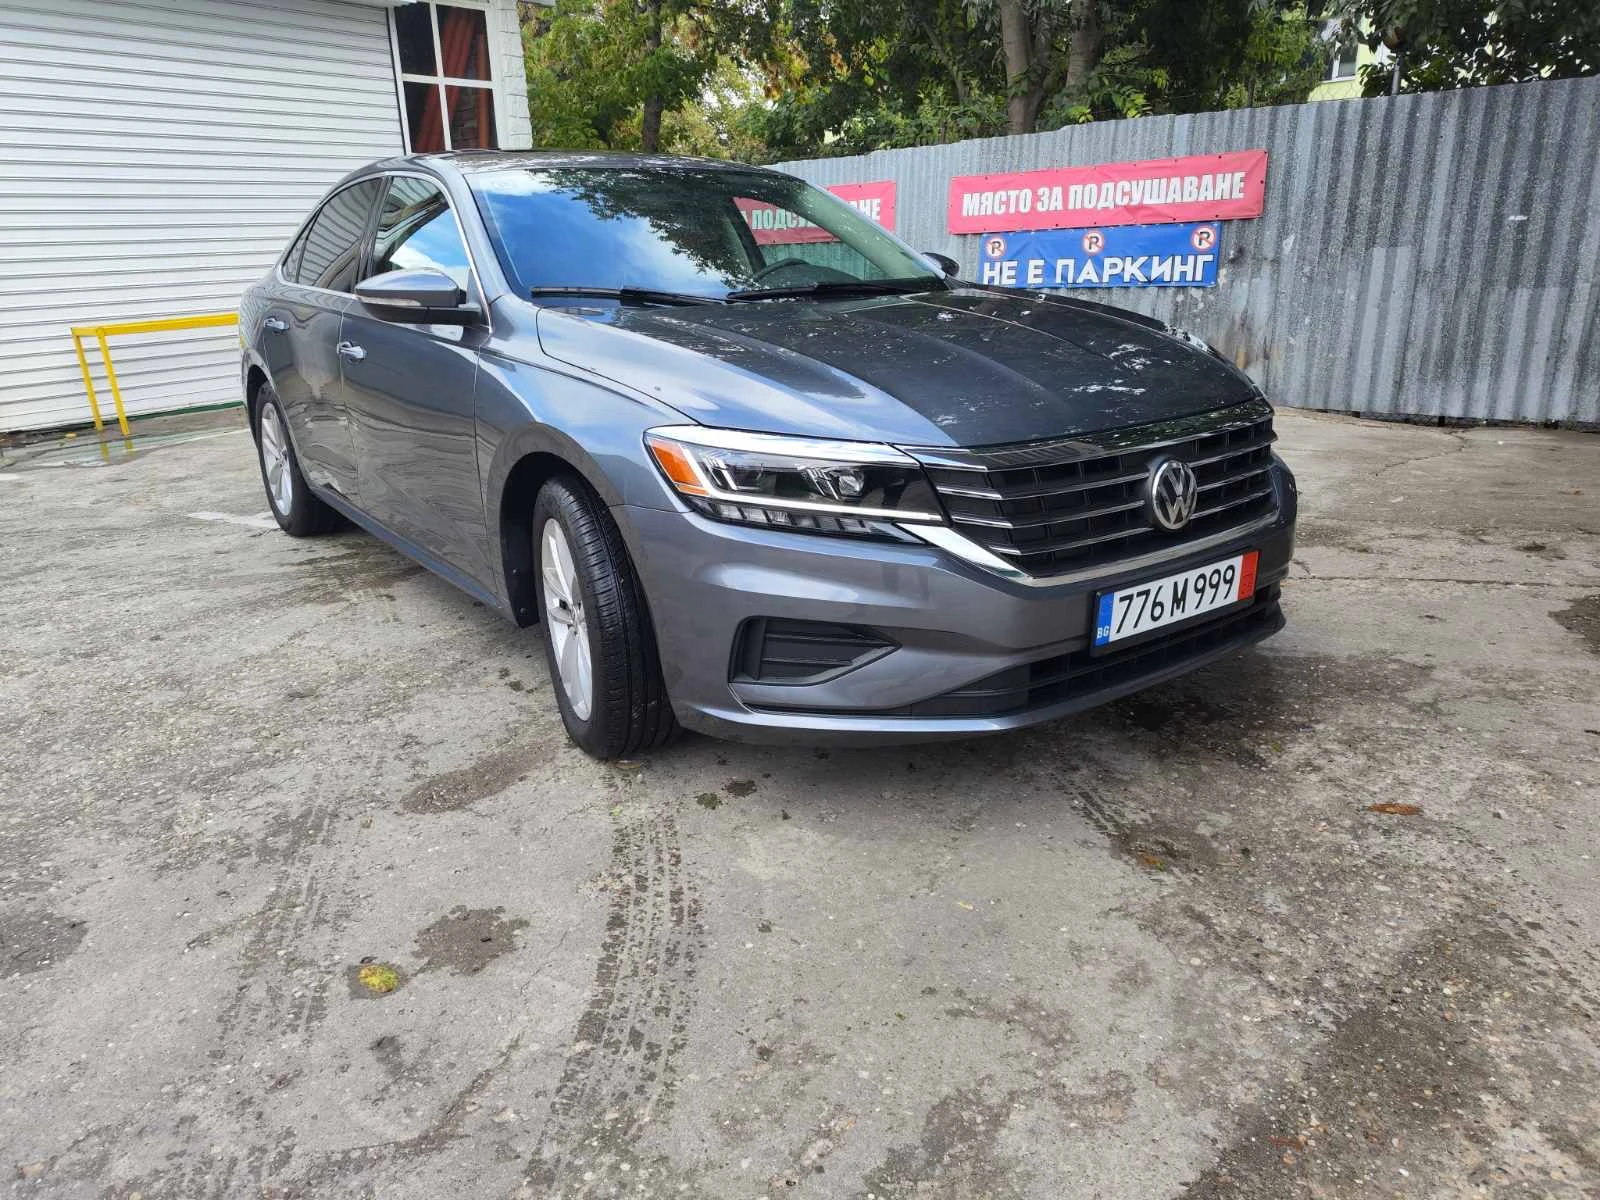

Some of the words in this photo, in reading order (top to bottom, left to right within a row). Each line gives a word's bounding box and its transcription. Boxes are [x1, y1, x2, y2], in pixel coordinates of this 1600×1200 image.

[962, 188, 1033, 217] МЯСТО
[1036, 186, 1063, 212] ЗА
[1068, 171, 1246, 210] ПОДСУШАВАНЕ
[983, 260, 1018, 286] НЕ
[1026, 259, 1045, 284] Е
[1055, 254, 1214, 284] ПАРКИНГ
[1115, 584, 1165, 634] 776
[1170, 577, 1189, 617] M
[1193, 564, 1236, 610] 999
[1097, 625, 1110, 639] BG
